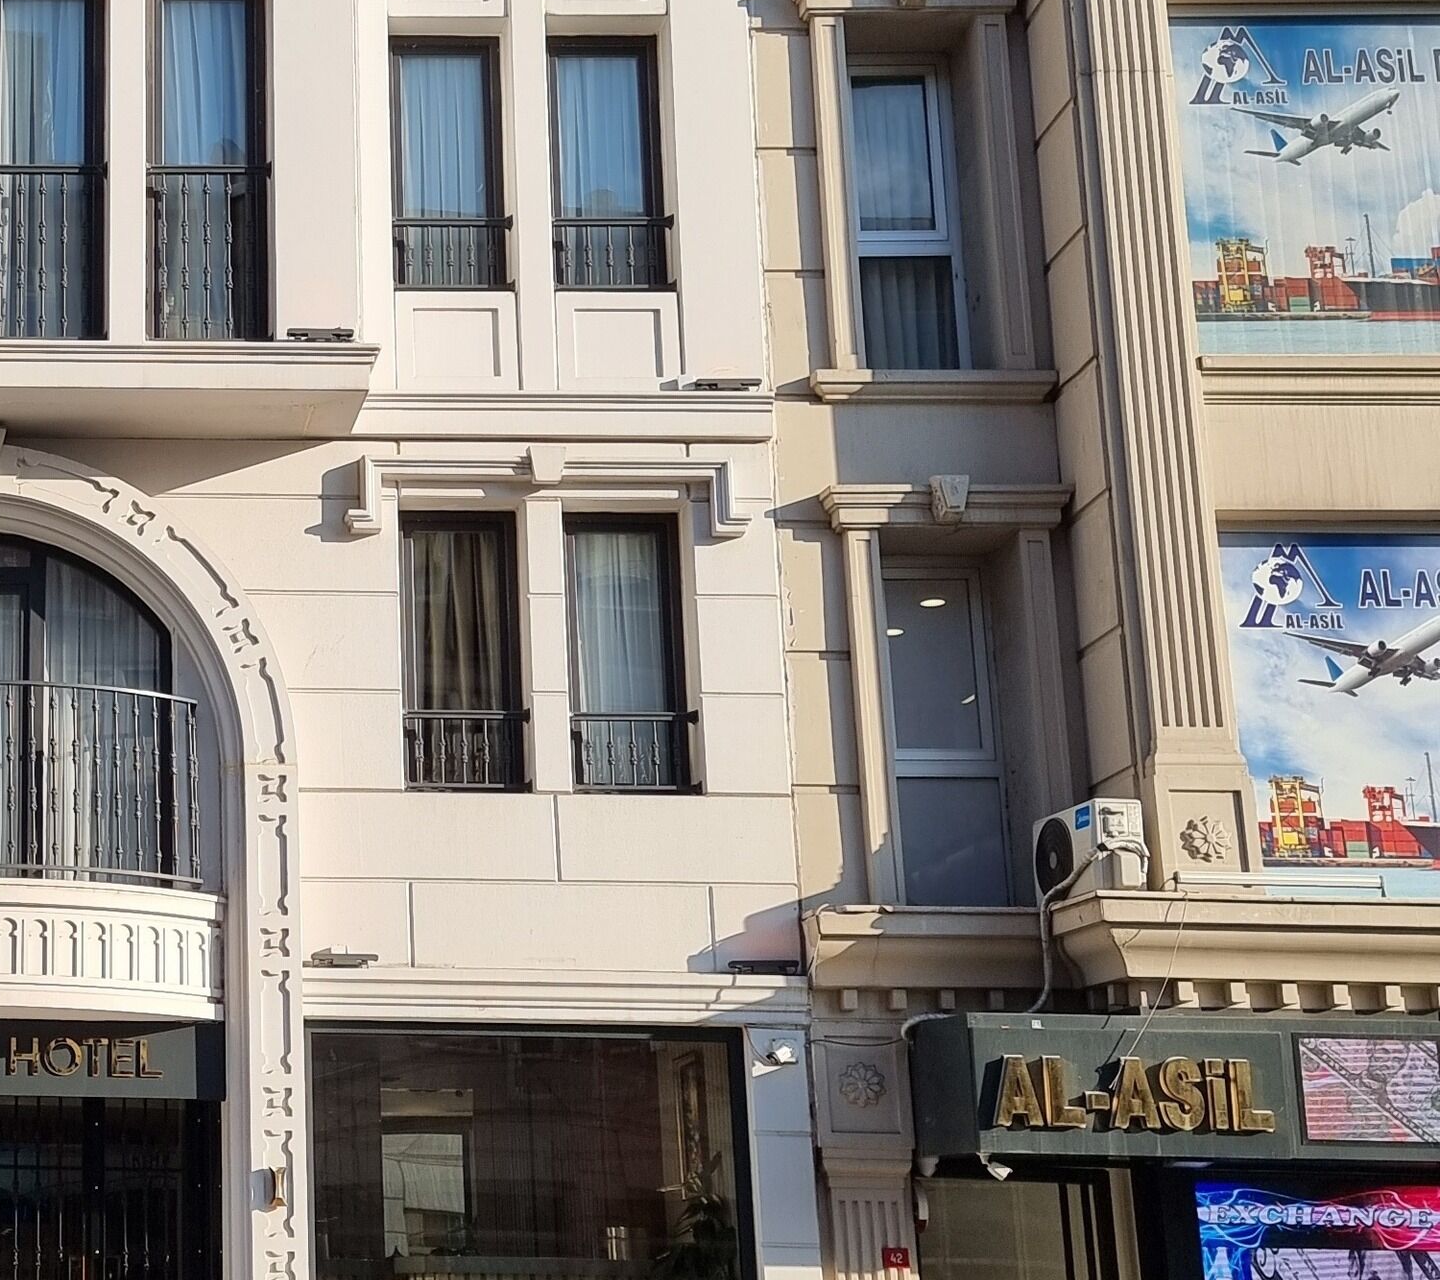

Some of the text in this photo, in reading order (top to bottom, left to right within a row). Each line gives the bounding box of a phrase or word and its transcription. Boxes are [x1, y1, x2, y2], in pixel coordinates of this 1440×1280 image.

[1359, 568, 1440, 608] AL-A
[5, 1036, 163, 1079] HOTEL
[1208, 1204, 1434, 1229] EXCHANGE
[890, 1252, 904, 1264] 42
